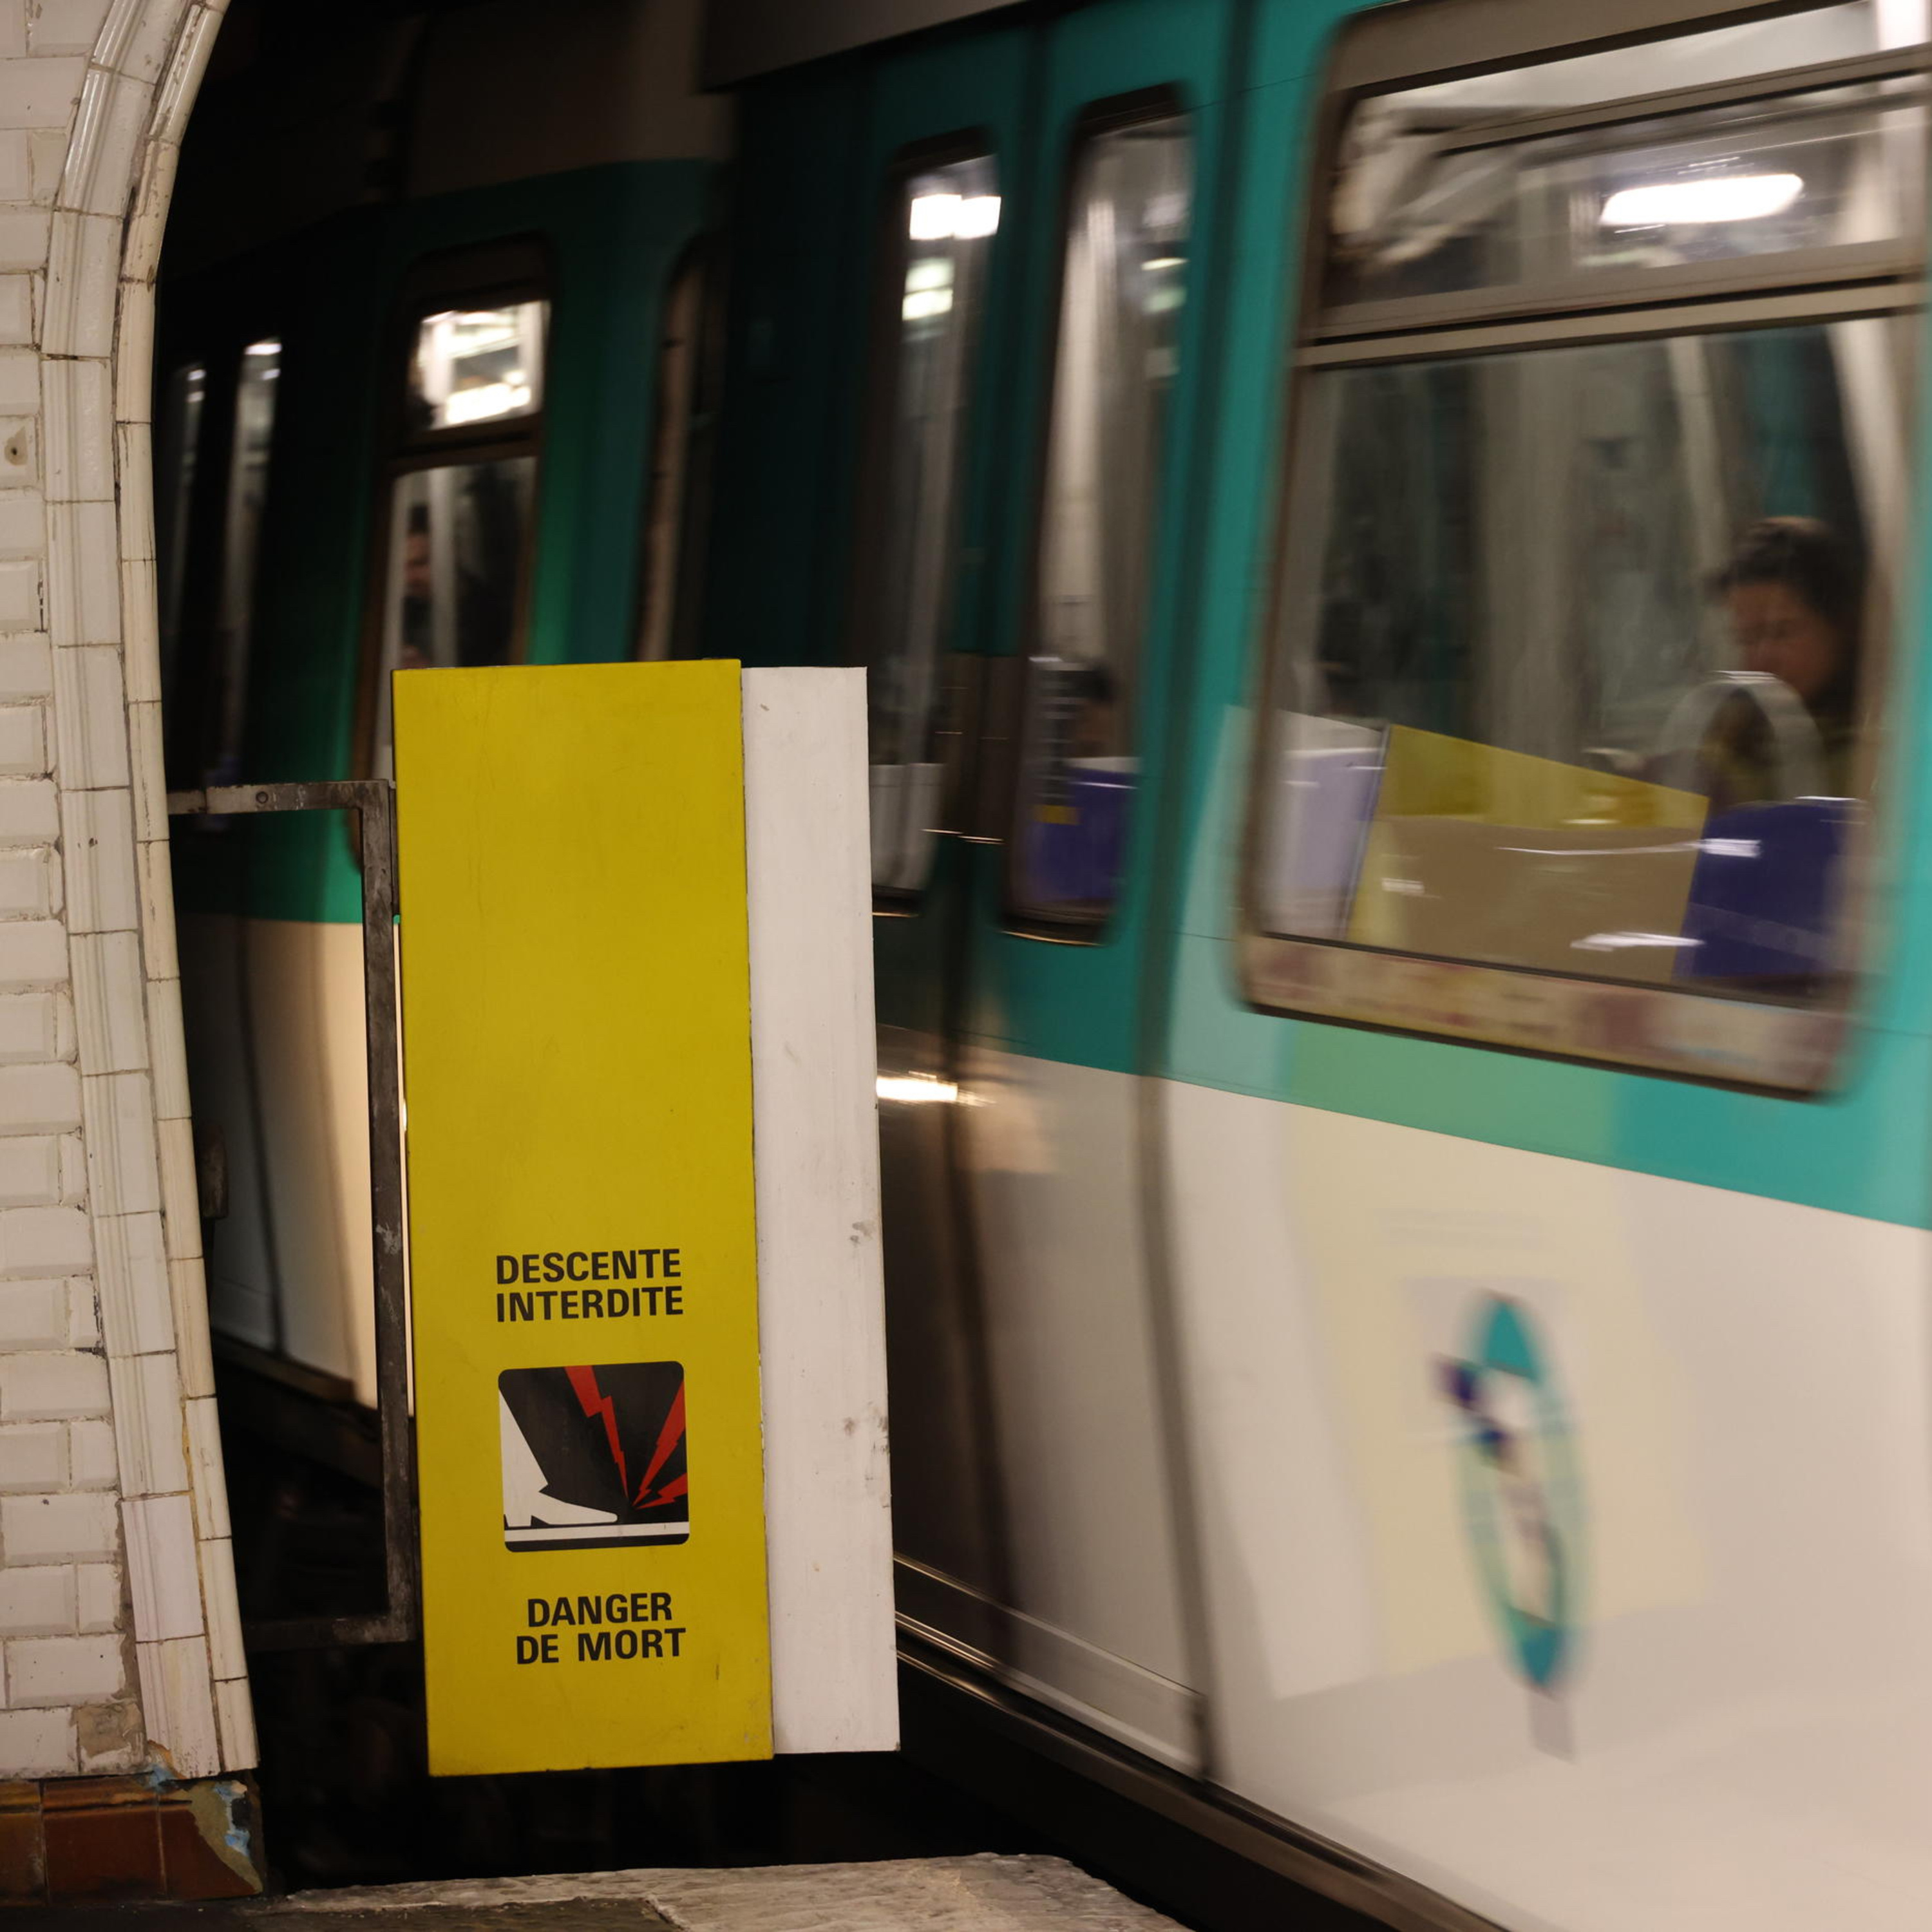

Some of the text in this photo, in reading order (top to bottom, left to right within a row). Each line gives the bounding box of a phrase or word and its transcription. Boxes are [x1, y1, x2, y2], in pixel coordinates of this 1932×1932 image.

[497, 1249, 681, 1284] DESCENTE
[497, 1286, 683, 1321] INTERDITE
[528, 1593, 672, 1627] DANGER
[517, 1628, 686, 1664] DE MORT
